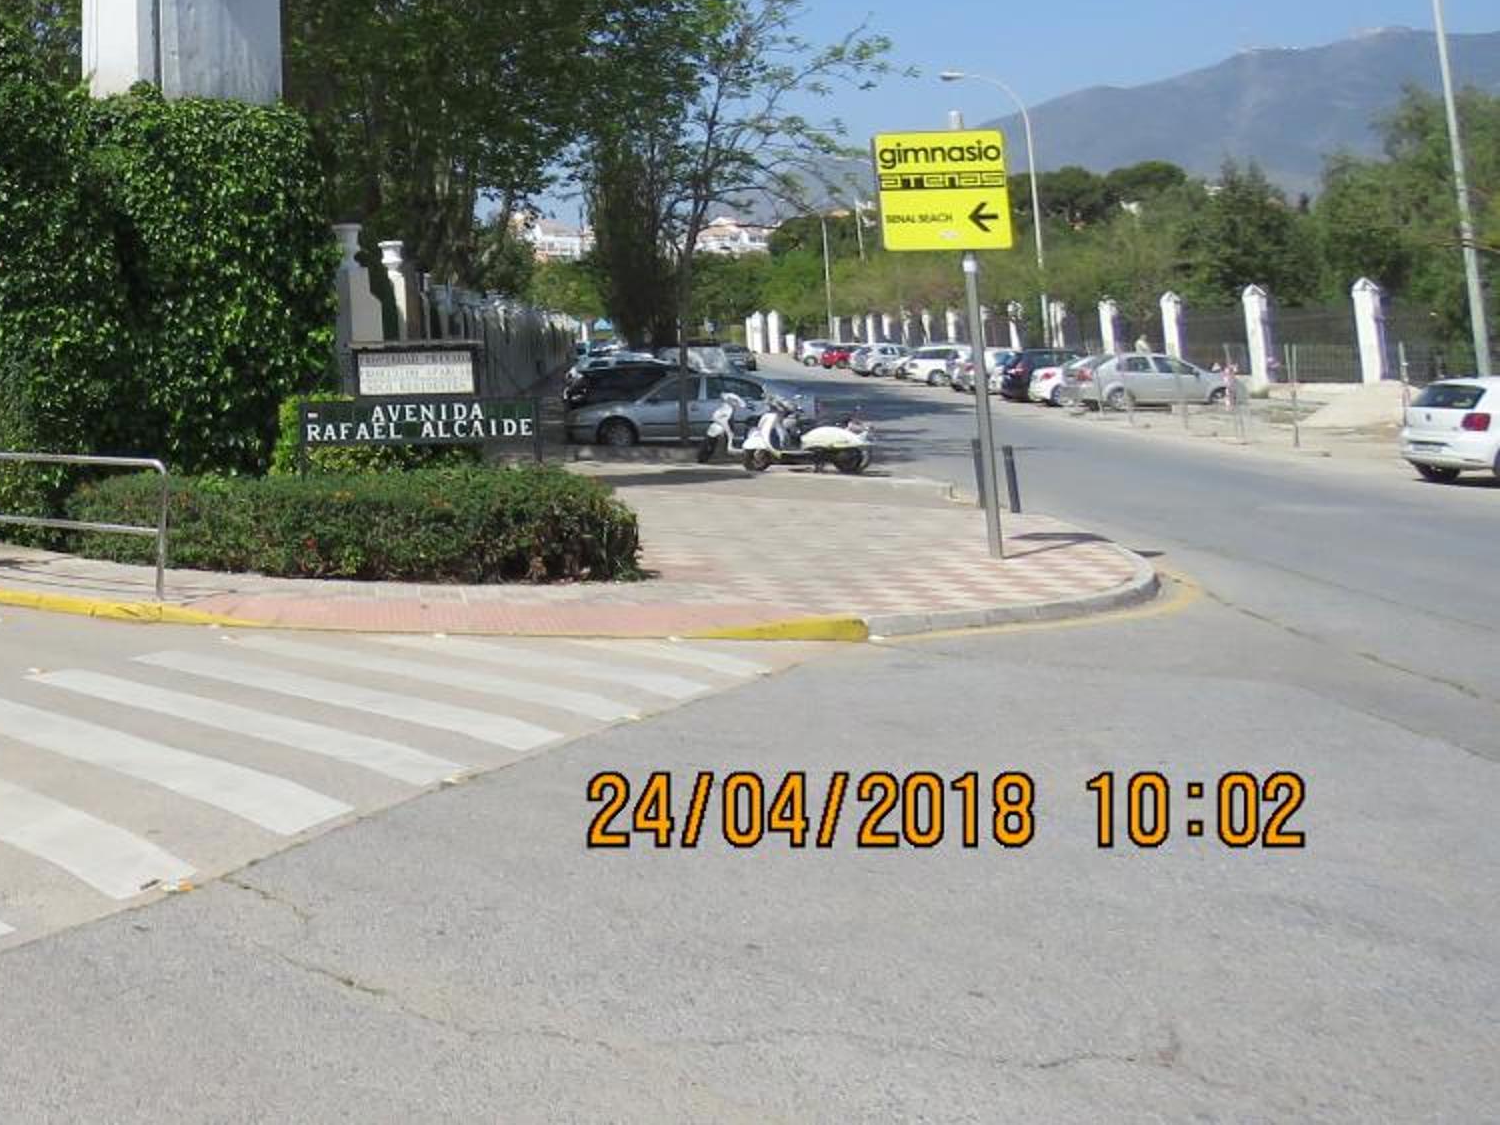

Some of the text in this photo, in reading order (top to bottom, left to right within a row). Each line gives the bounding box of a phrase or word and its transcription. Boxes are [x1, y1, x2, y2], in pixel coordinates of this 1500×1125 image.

[878, 138, 1001, 170] gimnasio
[371, 403, 485, 423] AVENIDA
[307, 418, 534, 442] RAFAEL ALCAIDE
